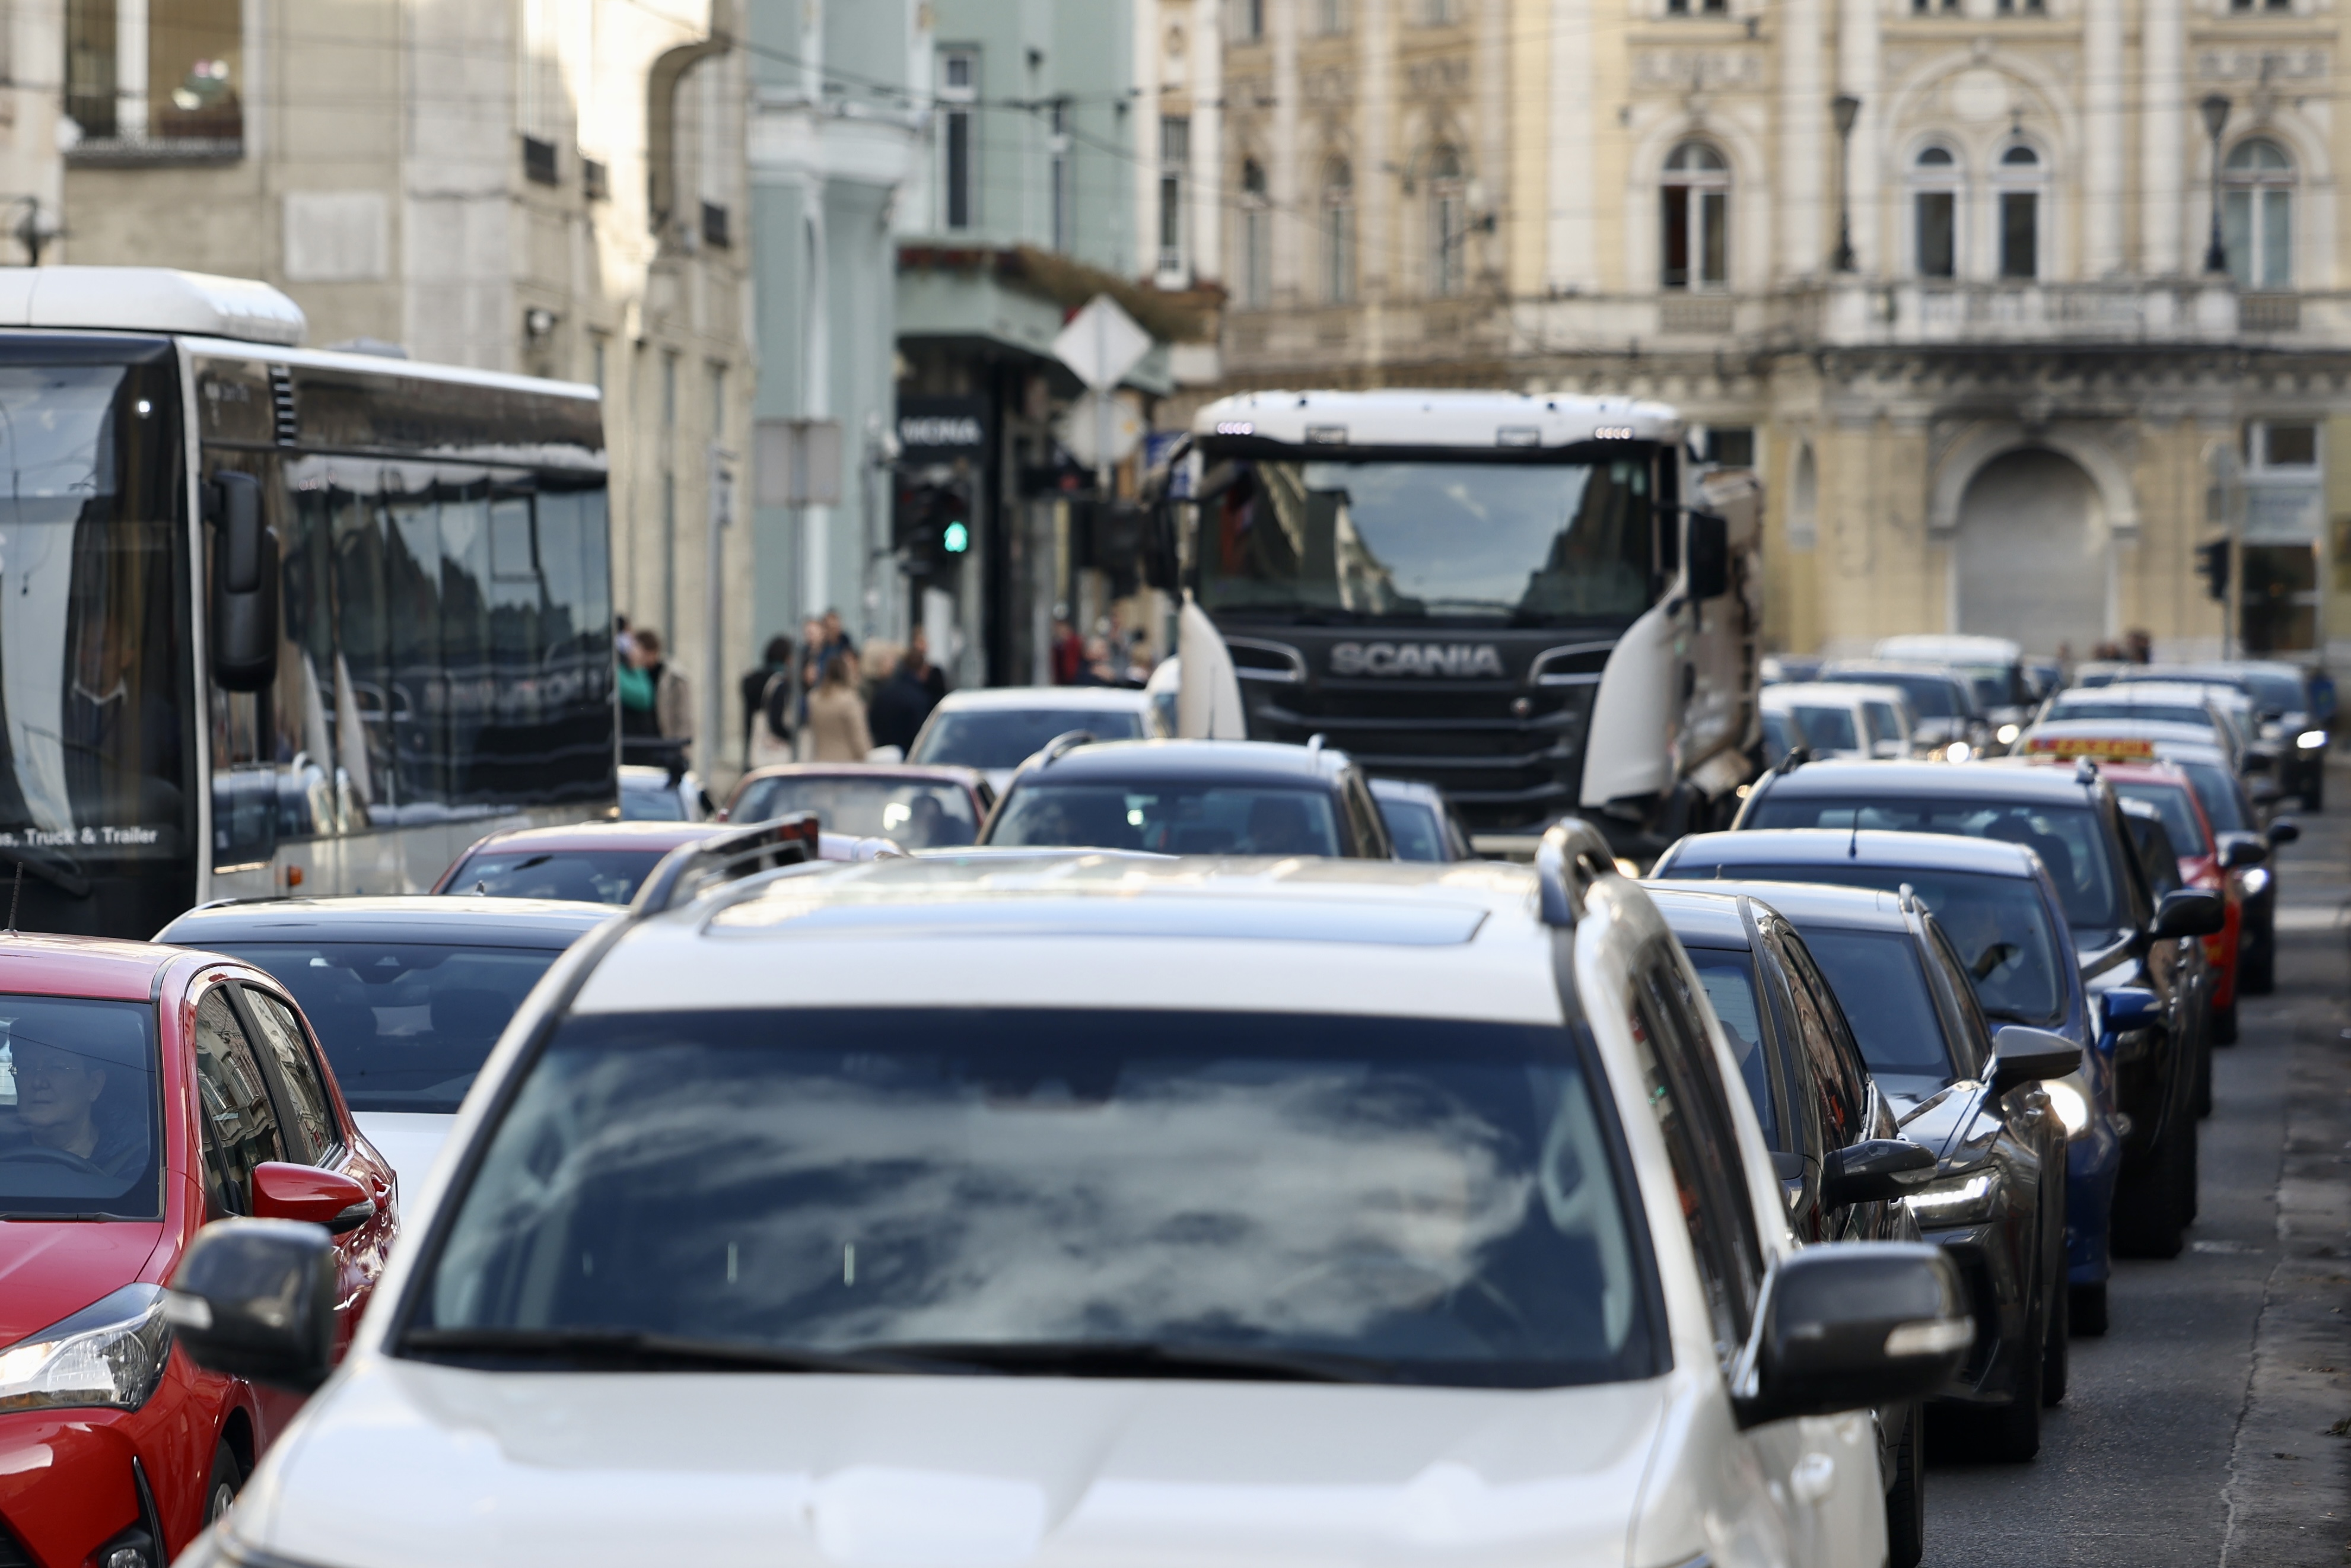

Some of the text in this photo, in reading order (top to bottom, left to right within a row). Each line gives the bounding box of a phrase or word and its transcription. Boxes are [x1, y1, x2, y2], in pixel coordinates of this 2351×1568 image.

[1331, 642, 1504, 676] SCANIA
[25, 828, 75, 845] Truck
[81, 827, 96, 844] &
[101, 826, 158, 843] Trailer
